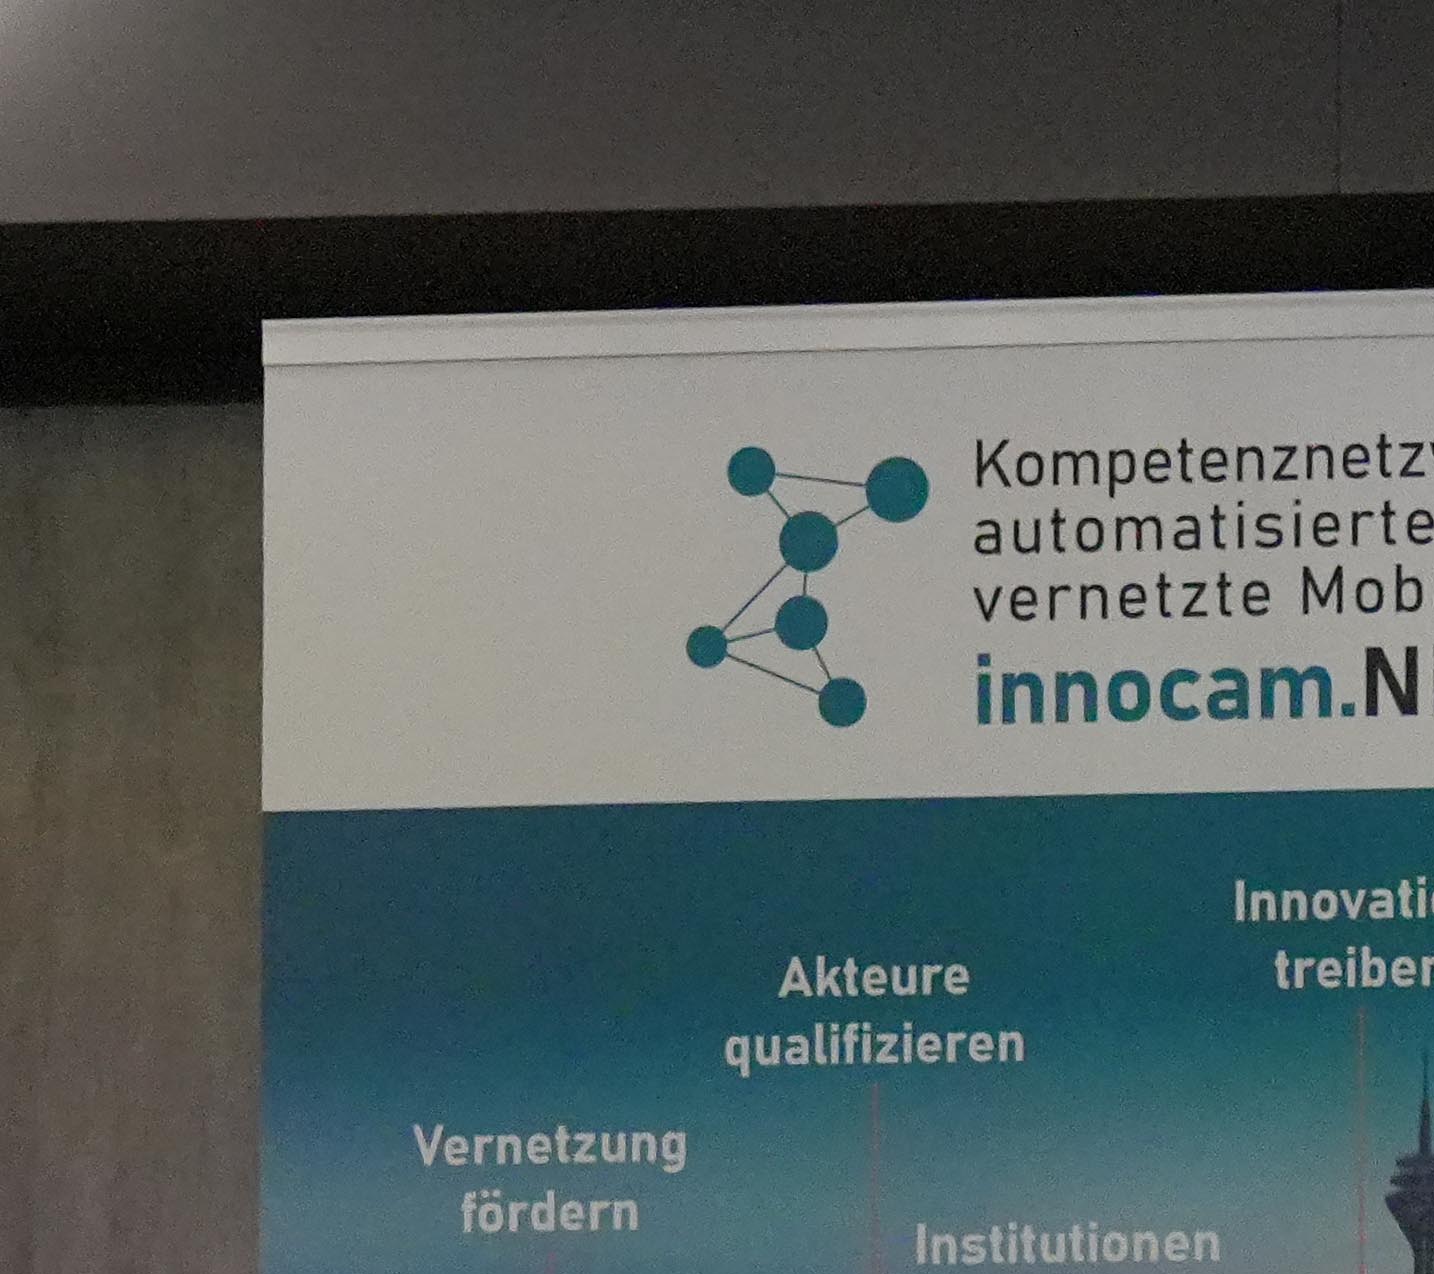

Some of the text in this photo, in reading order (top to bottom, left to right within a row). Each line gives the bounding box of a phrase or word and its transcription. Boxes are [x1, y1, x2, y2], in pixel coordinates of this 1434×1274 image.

[973, 498, 1434, 556] automatisierte
[973, 571, 1271, 622] vernetzte
[779, 955, 970, 997] Akteure
[724, 1022, 1025, 1078] qualifizieren
[413, 1124, 687, 1174] Vernetzung
[461, 1189, 639, 1233] fördern
[916, 1221, 1221, 1265] Institutionen
